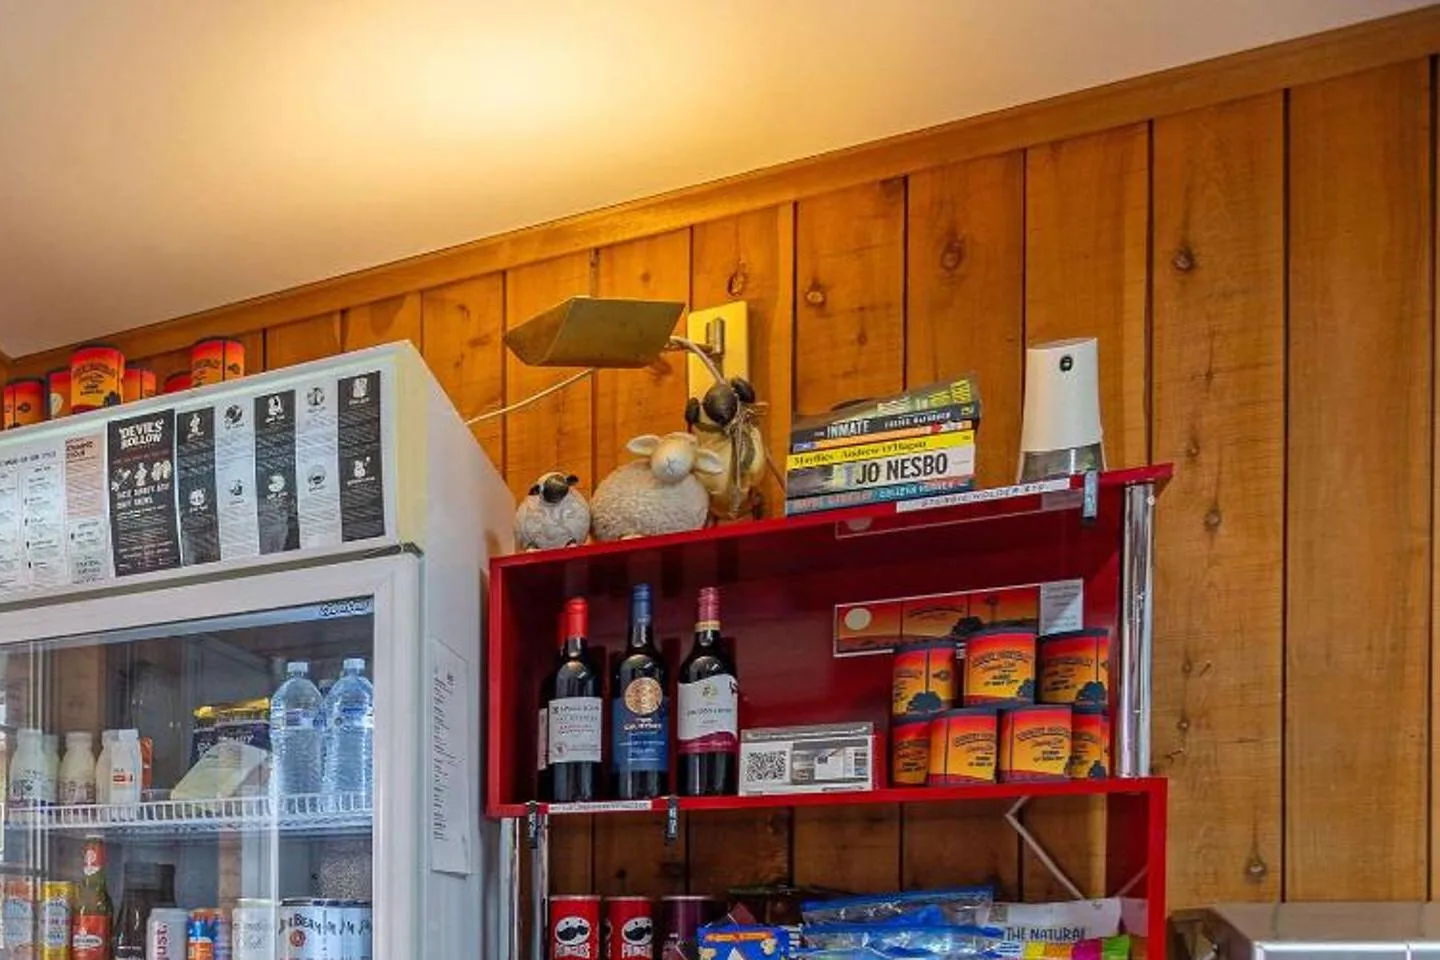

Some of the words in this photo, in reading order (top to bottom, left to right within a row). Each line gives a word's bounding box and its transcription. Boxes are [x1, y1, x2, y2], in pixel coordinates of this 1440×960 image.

[826, 420, 872, 440] INMATE
[855, 461, 881, 486] JO
[1006, 926, 1028, 942] THE
[1029, 927, 1087, 942] NATURAL
